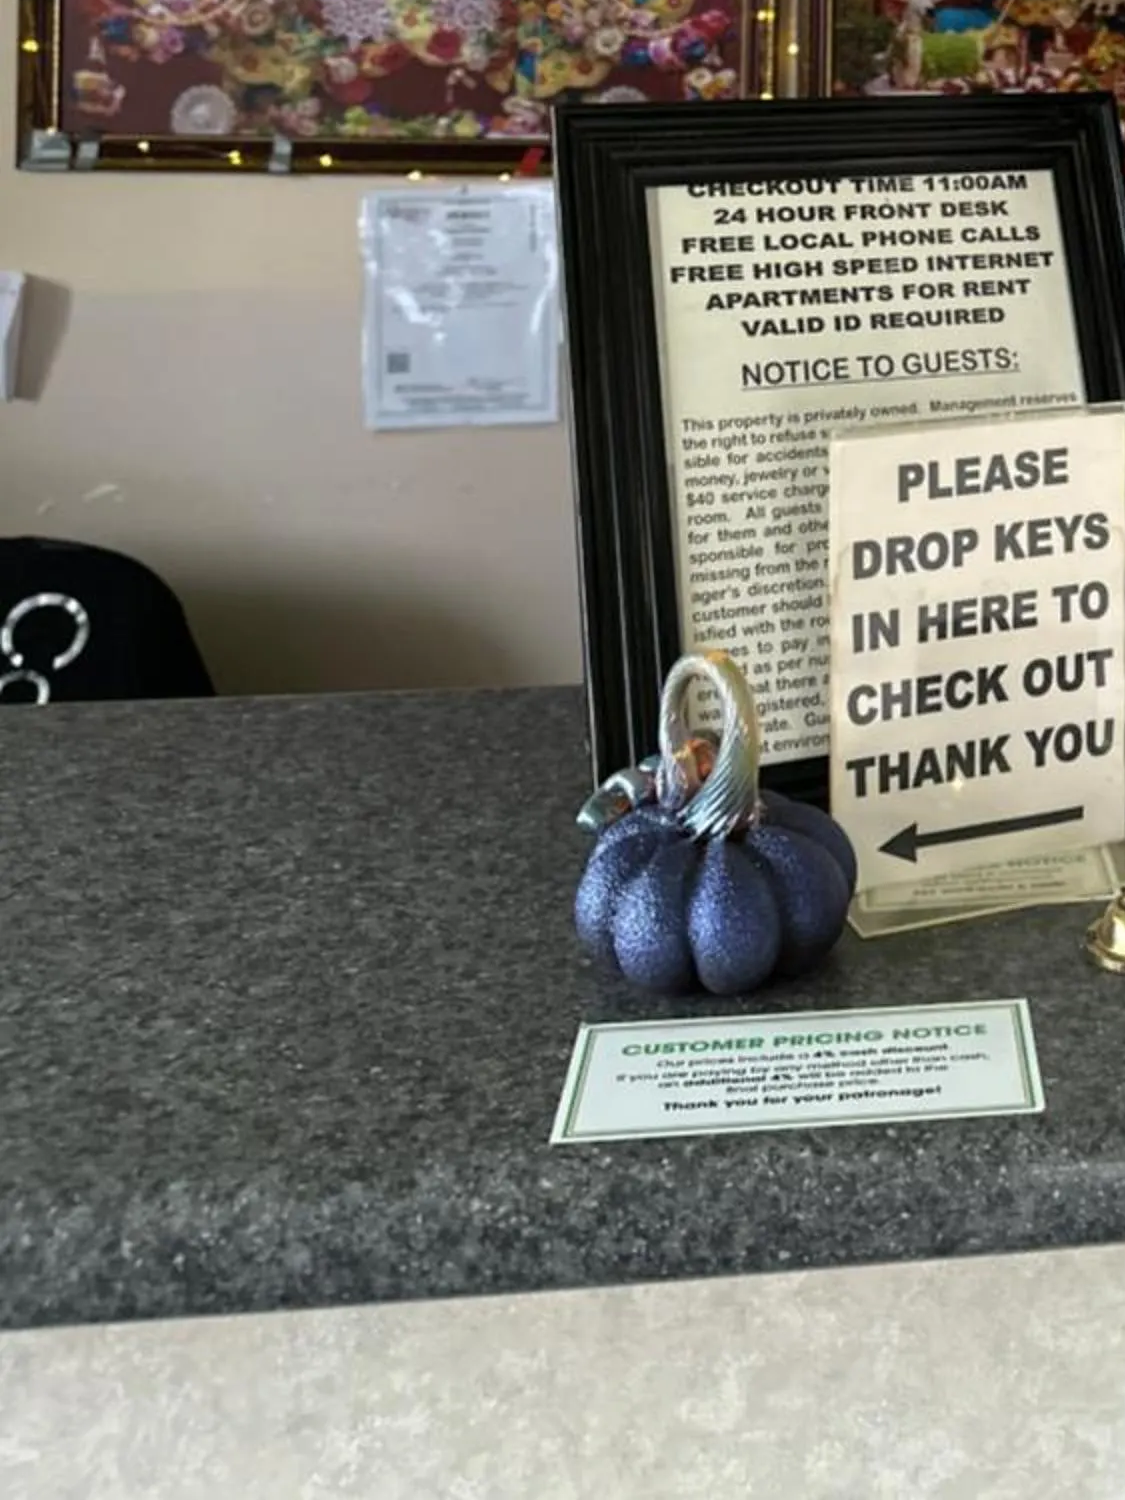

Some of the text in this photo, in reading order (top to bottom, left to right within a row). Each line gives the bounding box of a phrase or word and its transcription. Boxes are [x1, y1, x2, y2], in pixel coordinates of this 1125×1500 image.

[686, 174, 1028, 198] CHECKOUT TIME 11:00AM
[714, 200, 1008, 224] 24 HOUR FRONT DESK
[682, 225, 1040, 254] FREE LOCAL PHONE CALLS
[671, 252, 1053, 283] FREE HIGH SPEED INTERNET
[706, 279, 1030, 310] APARTMENTS FOR RENT
[742, 307, 1004, 337] VALID ID REQUIRED
[741, 347, 1020, 386] NOTICE TO GUESTS:
[682, 418, 714, 431] This
[718, 413, 783, 431] property
[788, 411, 800, 423] is
[804, 403, 865, 423] privately
[930, 395, 1016, 412] Management
[1019, 392, 1077, 406] reserves
[682, 437, 708, 450] the
[711, 433, 748, 450] right
[751, 433, 766, 445] to
[770, 429, 816, 443] refuse
[684, 455, 720, 469] sible
[727, 452, 748, 465] for
[898, 448, 1069, 503] PLEASE
[722, 487, 777, 503] service
[687, 503, 822, 525] room. All guests
[688, 531, 709, 544] for
[718, 528, 756, 542] them
[763, 524, 792, 538] and
[853, 512, 1110, 580] DROP KEYS
[689, 545, 764, 565] sponsible
[775, 541, 796, 554] for
[690, 559, 819, 582] missing from the
[691, 586, 740, 605] ager's
[692, 596, 822, 622] customer should
[852, 581, 1109, 653] IN HERE TO
[694, 625, 736, 642] isfied
[742, 620, 775, 636] with
[781, 617, 804, 631] the
[757, 641, 773, 654] to
[781, 637, 808, 654] pay
[754, 662, 771, 674] as
[777, 658, 802, 674] per
[776, 674, 817, 690] there
[847, 649, 1114, 726] CHECK OUT
[846, 718, 1115, 797] THANK YOU
[622, 1024, 988, 1056] CUSTOMER PRICING NOTICE
[657, 1059, 685, 1069] Our
[688, 1056, 735, 1068] prices
[738, 1052, 794, 1063] include
[813, 1049, 836, 1058] 4%
[840, 1047, 876, 1057] cash
[663, 1084, 942, 1112] Thank you for your patronage!
